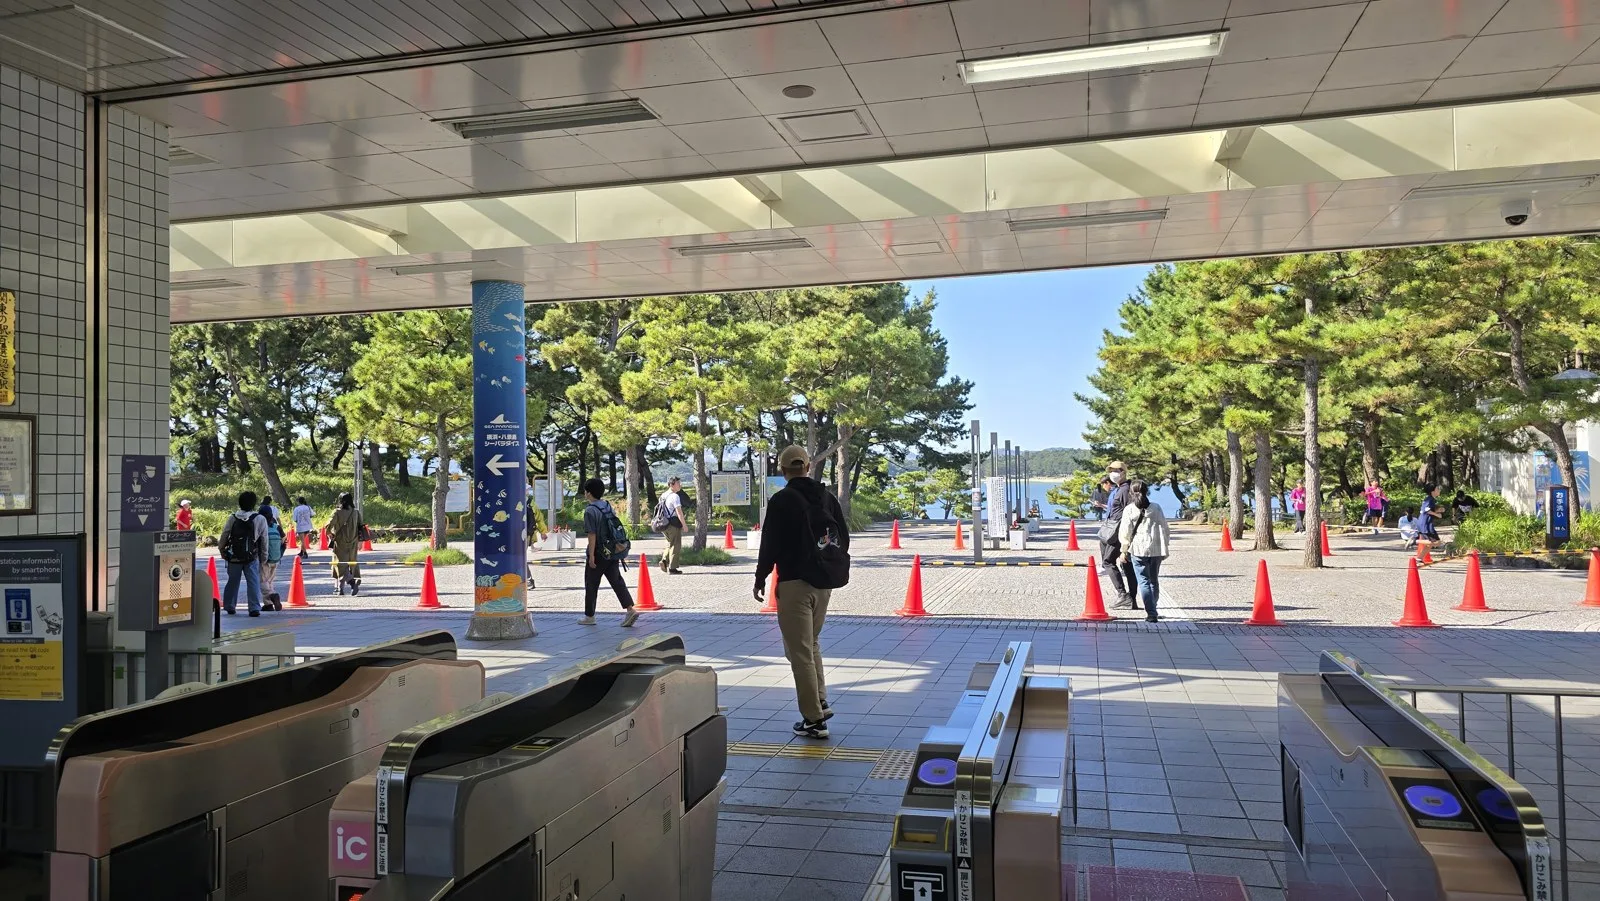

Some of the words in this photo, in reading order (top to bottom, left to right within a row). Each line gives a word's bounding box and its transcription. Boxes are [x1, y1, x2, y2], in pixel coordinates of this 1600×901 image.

[1556, 492, 1564, 518] お手洗い
[21, 566, 61, 574] smartphone
[22, 557, 61, 565] information
[959, 805, 968, 854] かけこみ禁止
[336, 826, 368, 861] ic
